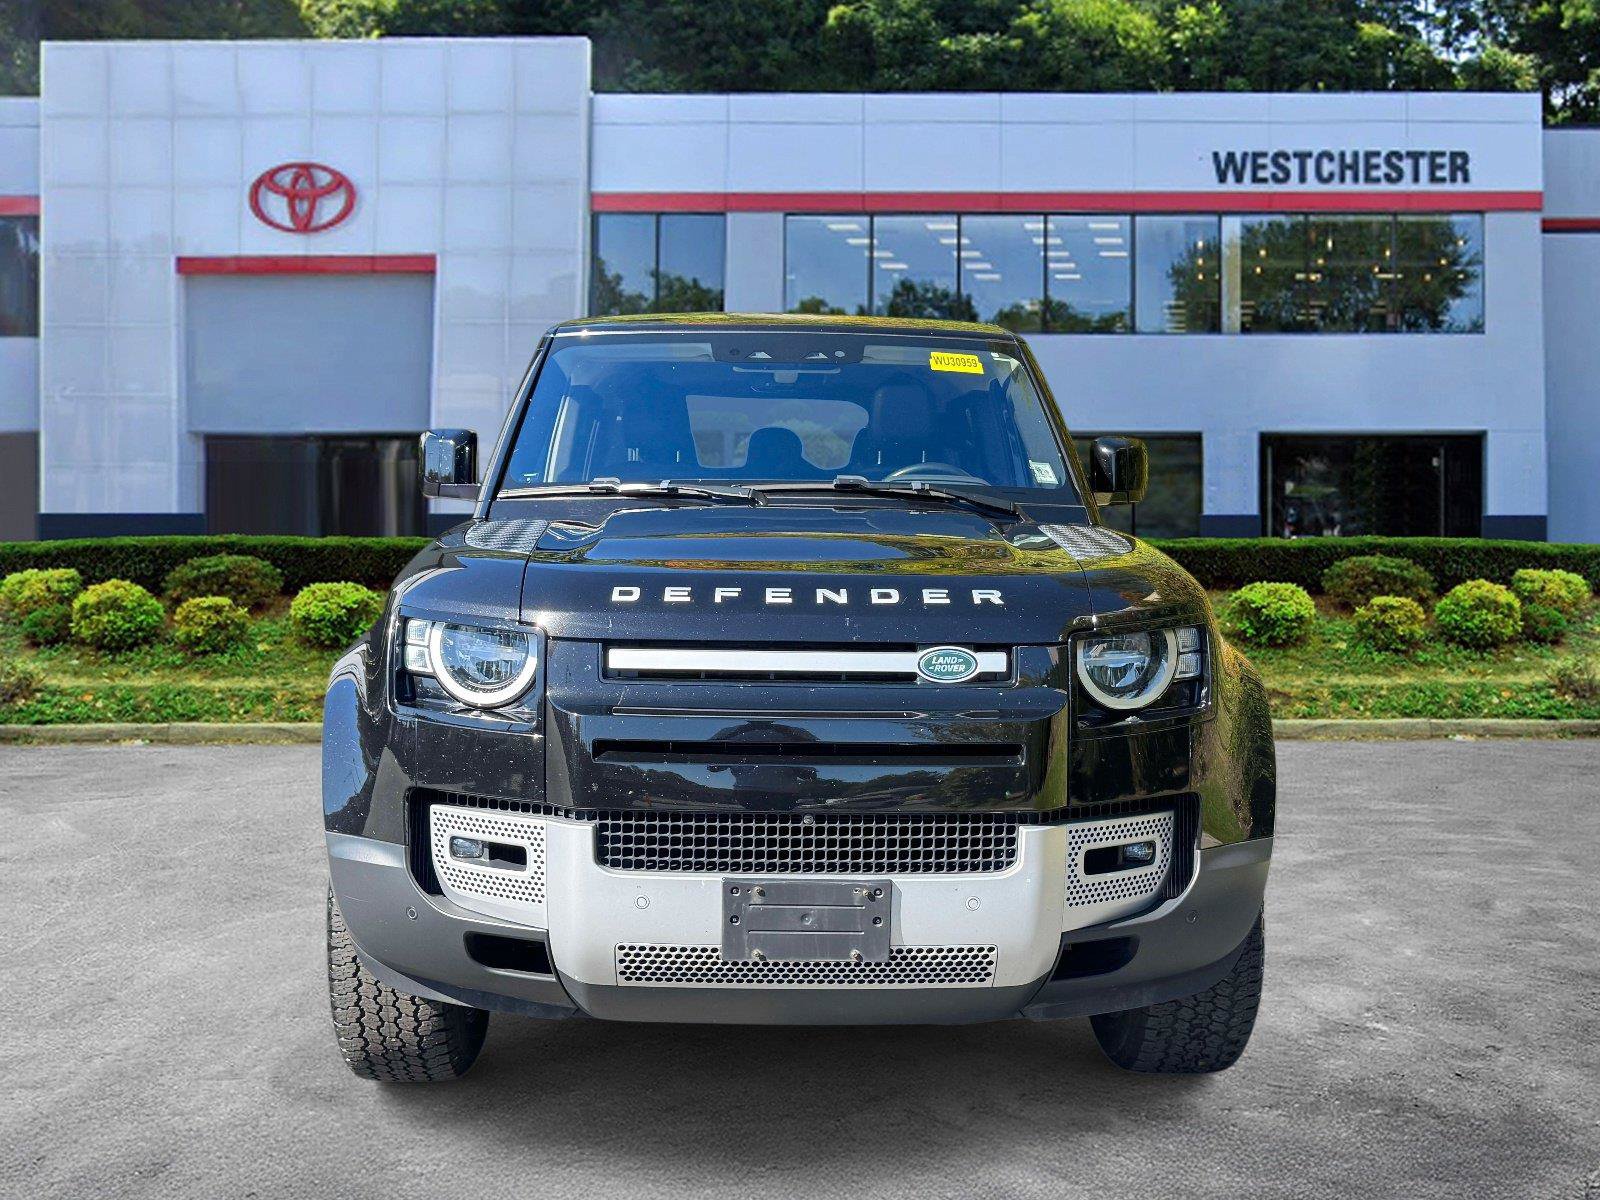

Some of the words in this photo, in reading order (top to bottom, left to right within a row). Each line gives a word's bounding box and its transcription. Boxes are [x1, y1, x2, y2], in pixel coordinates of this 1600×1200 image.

[1212, 150, 1471, 184] WESTCHESTER
[932, 355, 978, 368] WU30959
[611, 586, 1005, 605] DEFENDER
[932, 656, 958, 665] LAND
[933, 664, 966, 672] ROVER
